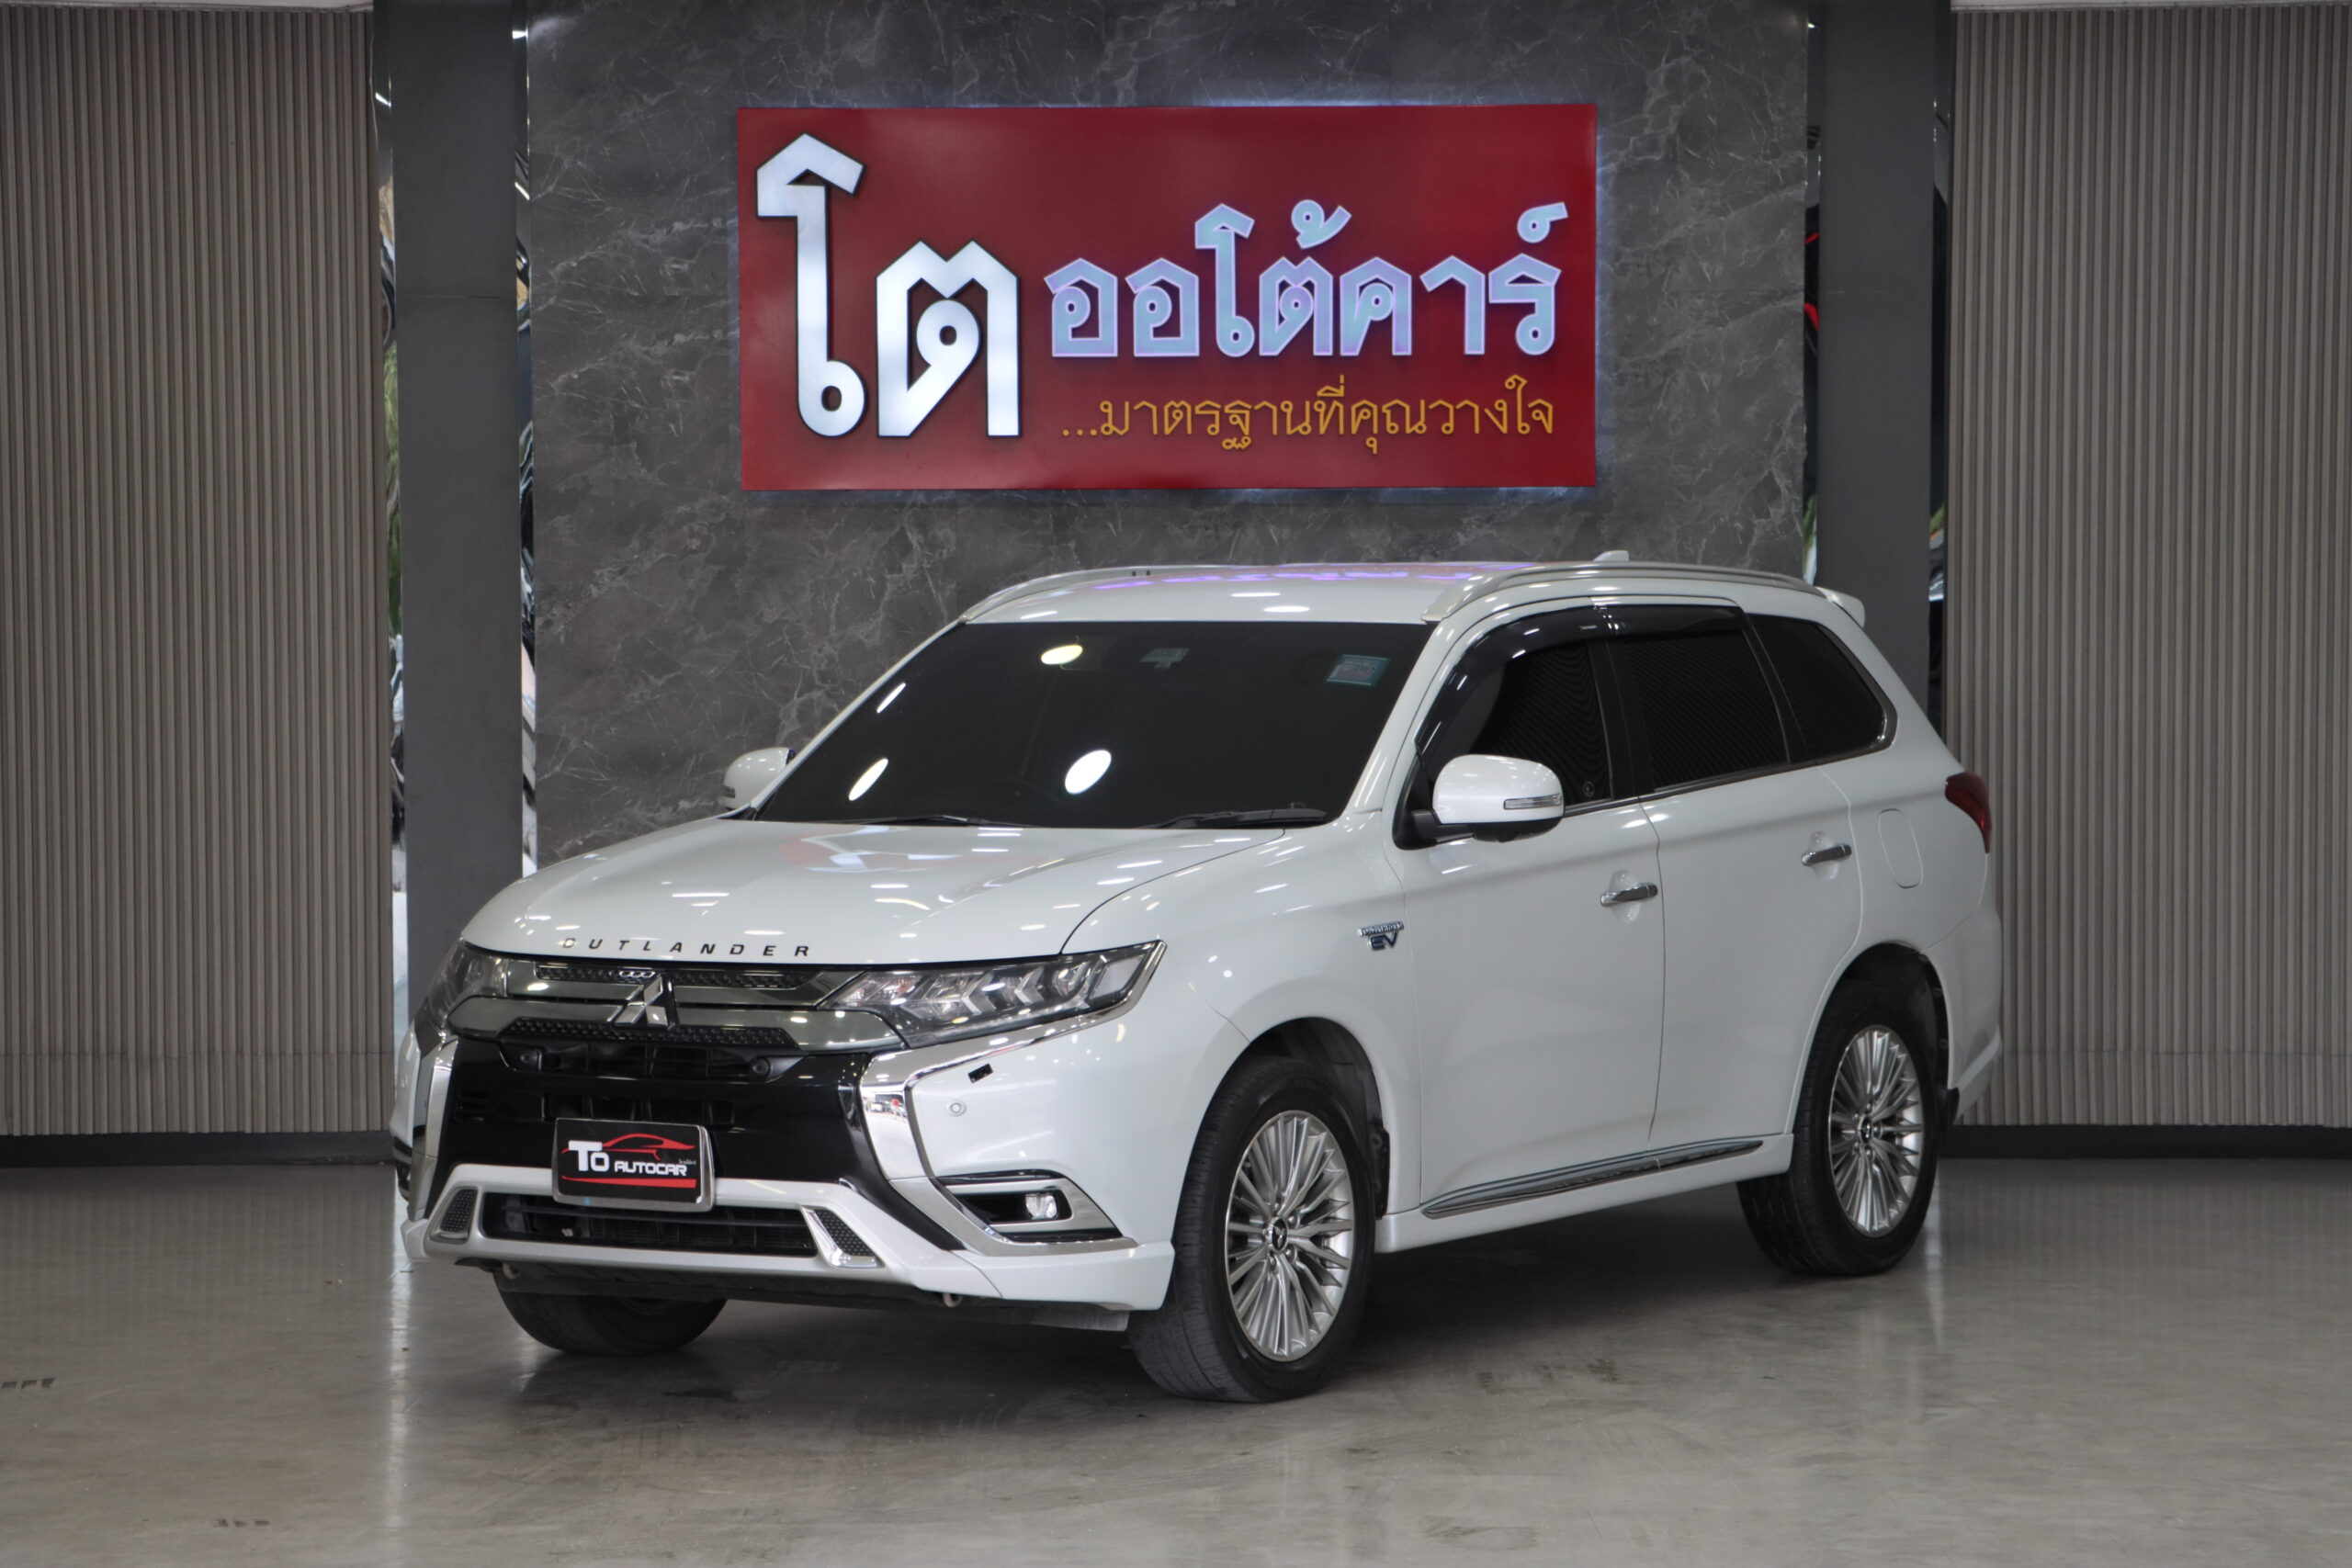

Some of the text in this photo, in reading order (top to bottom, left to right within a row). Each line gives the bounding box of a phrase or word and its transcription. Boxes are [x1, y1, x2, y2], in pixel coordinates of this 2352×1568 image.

[755, 132, 1569, 438] โต ออโต้คาร์
[560, 937, 810, 957] OUTLANDER
[614, 1160, 687, 1177] AUTOCAR
